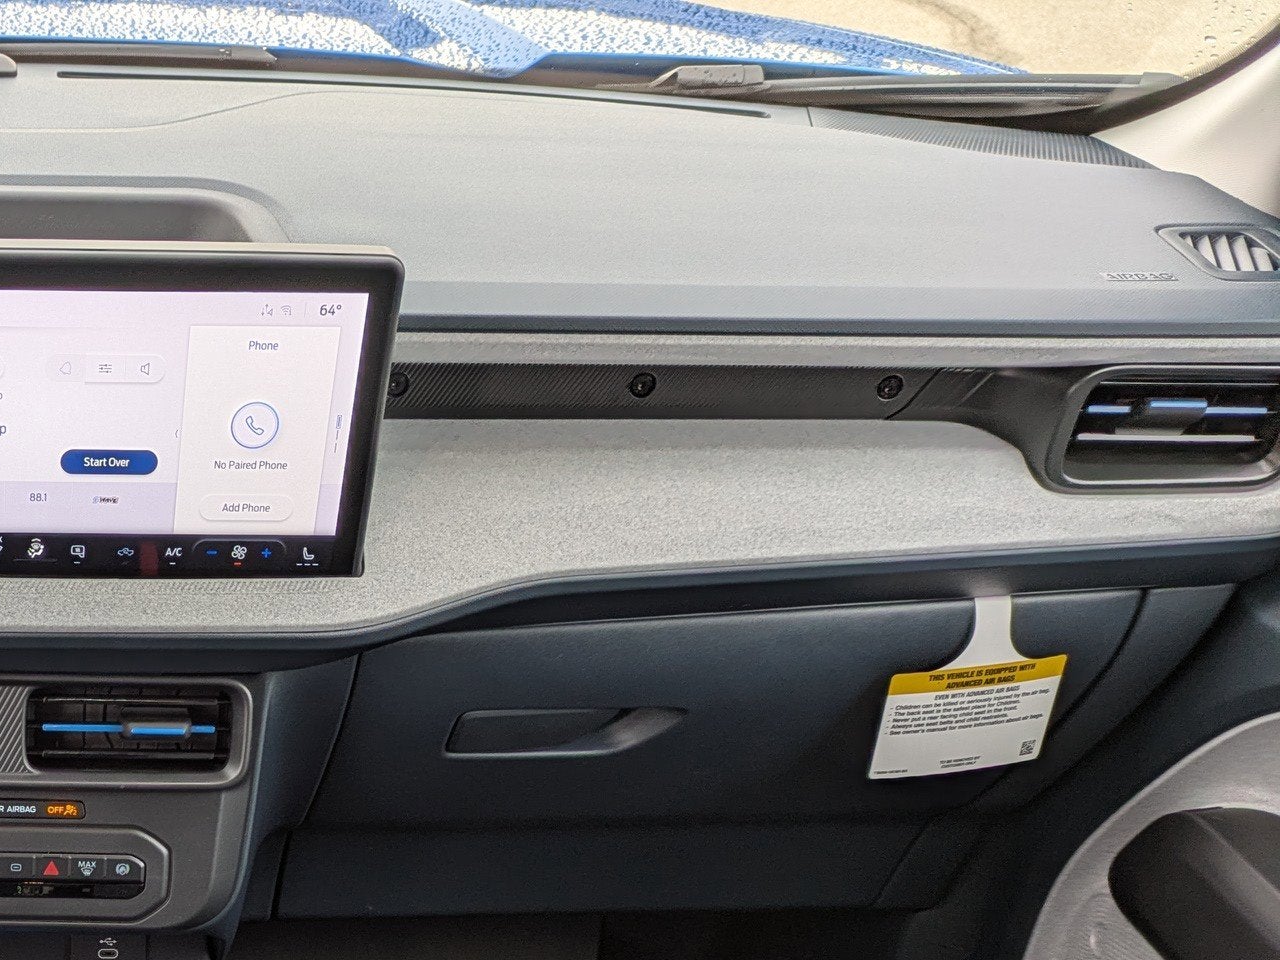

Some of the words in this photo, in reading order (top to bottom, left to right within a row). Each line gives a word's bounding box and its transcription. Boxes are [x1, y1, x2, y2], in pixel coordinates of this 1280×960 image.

[319, 304, 342, 316] 64°
[248, 341, 279, 351] Phone
[83, 457, 105, 467] Start
[108, 457, 130, 467] Over
[214, 460, 225, 470] No
[228, 460, 255, 470] Paired
[258, 460, 288, 471] Phone
[29, 493, 48, 502] 88.1
[222, 503, 239, 513] Add
[241, 503, 270, 513] Phone
[165, 547, 182, 557] A/C
[929, 674, 945, 682] THIS
[947, 671, 975, 680] VEHICLE
[985, 666, 1018, 675] EQUIPPED
[1019, 663, 1036, 671] WITH
[945, 679, 982, 689] ADVANCED
[983, 678, 996, 686] AIR
[997, 675, 1015, 683] BAGS
[966, 689, 994, 697] ADVANCED
[973, 719, 1005, 727] information
[7, 805, 36, 813] AIRBAG
[47, 806, 64, 814] OFF
